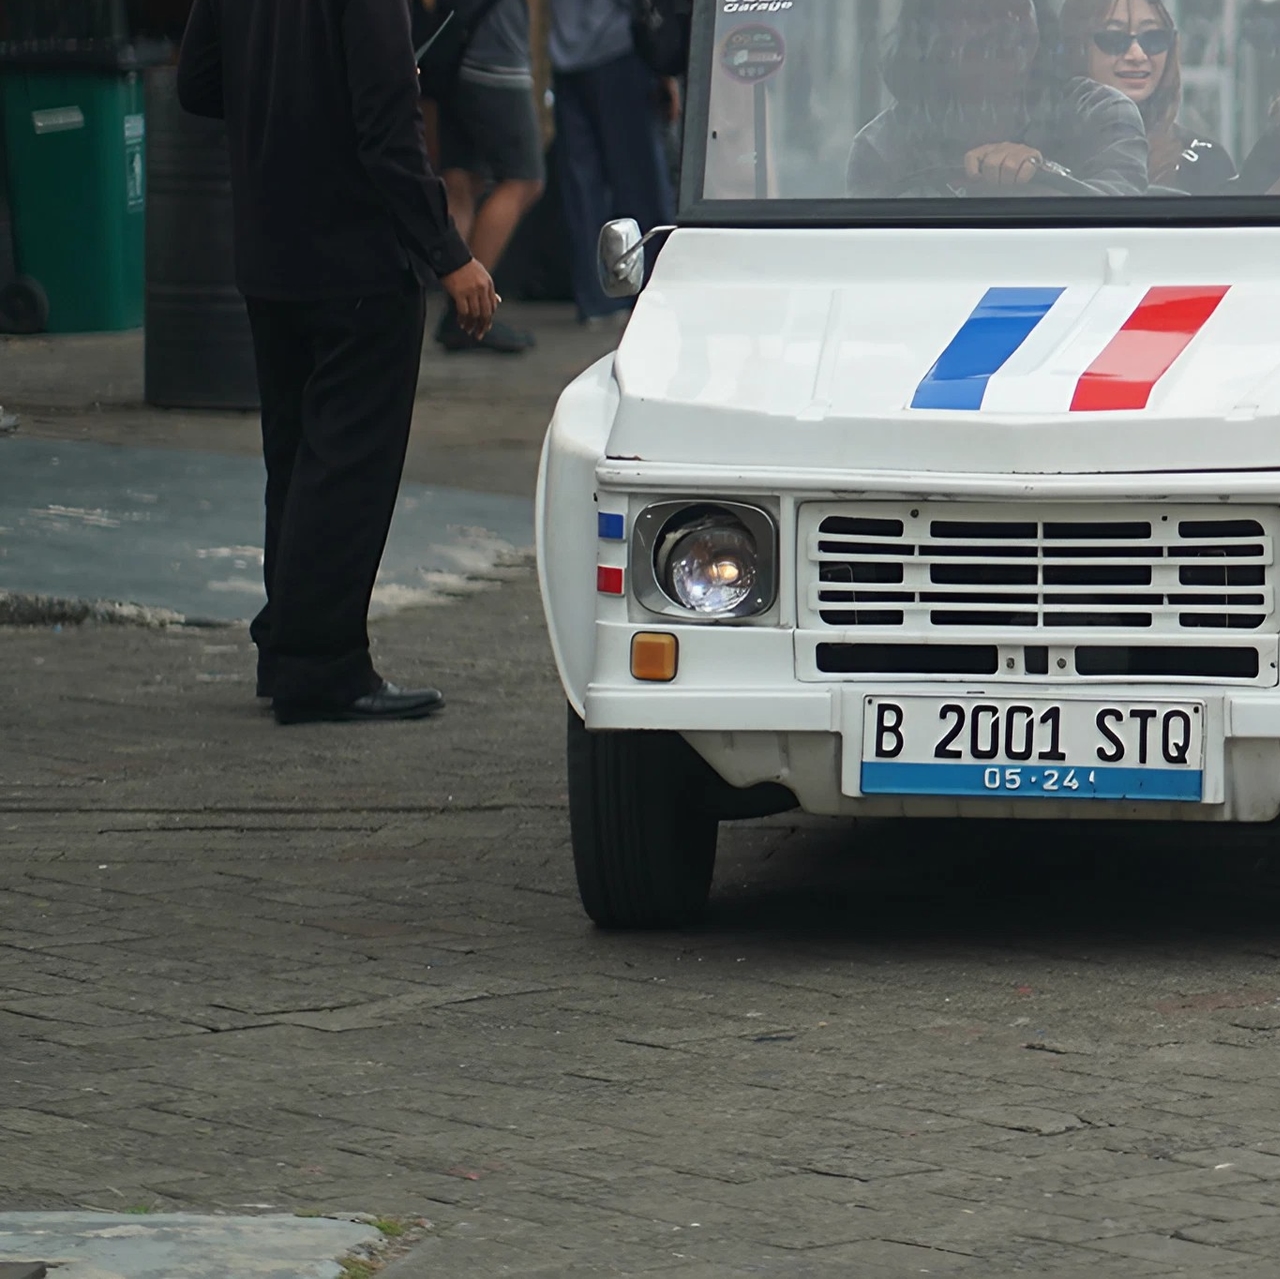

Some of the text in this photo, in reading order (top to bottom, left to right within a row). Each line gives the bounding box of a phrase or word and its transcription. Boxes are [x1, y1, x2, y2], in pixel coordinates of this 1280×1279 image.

[875, 703, 1191, 764] B 2001 STQ
